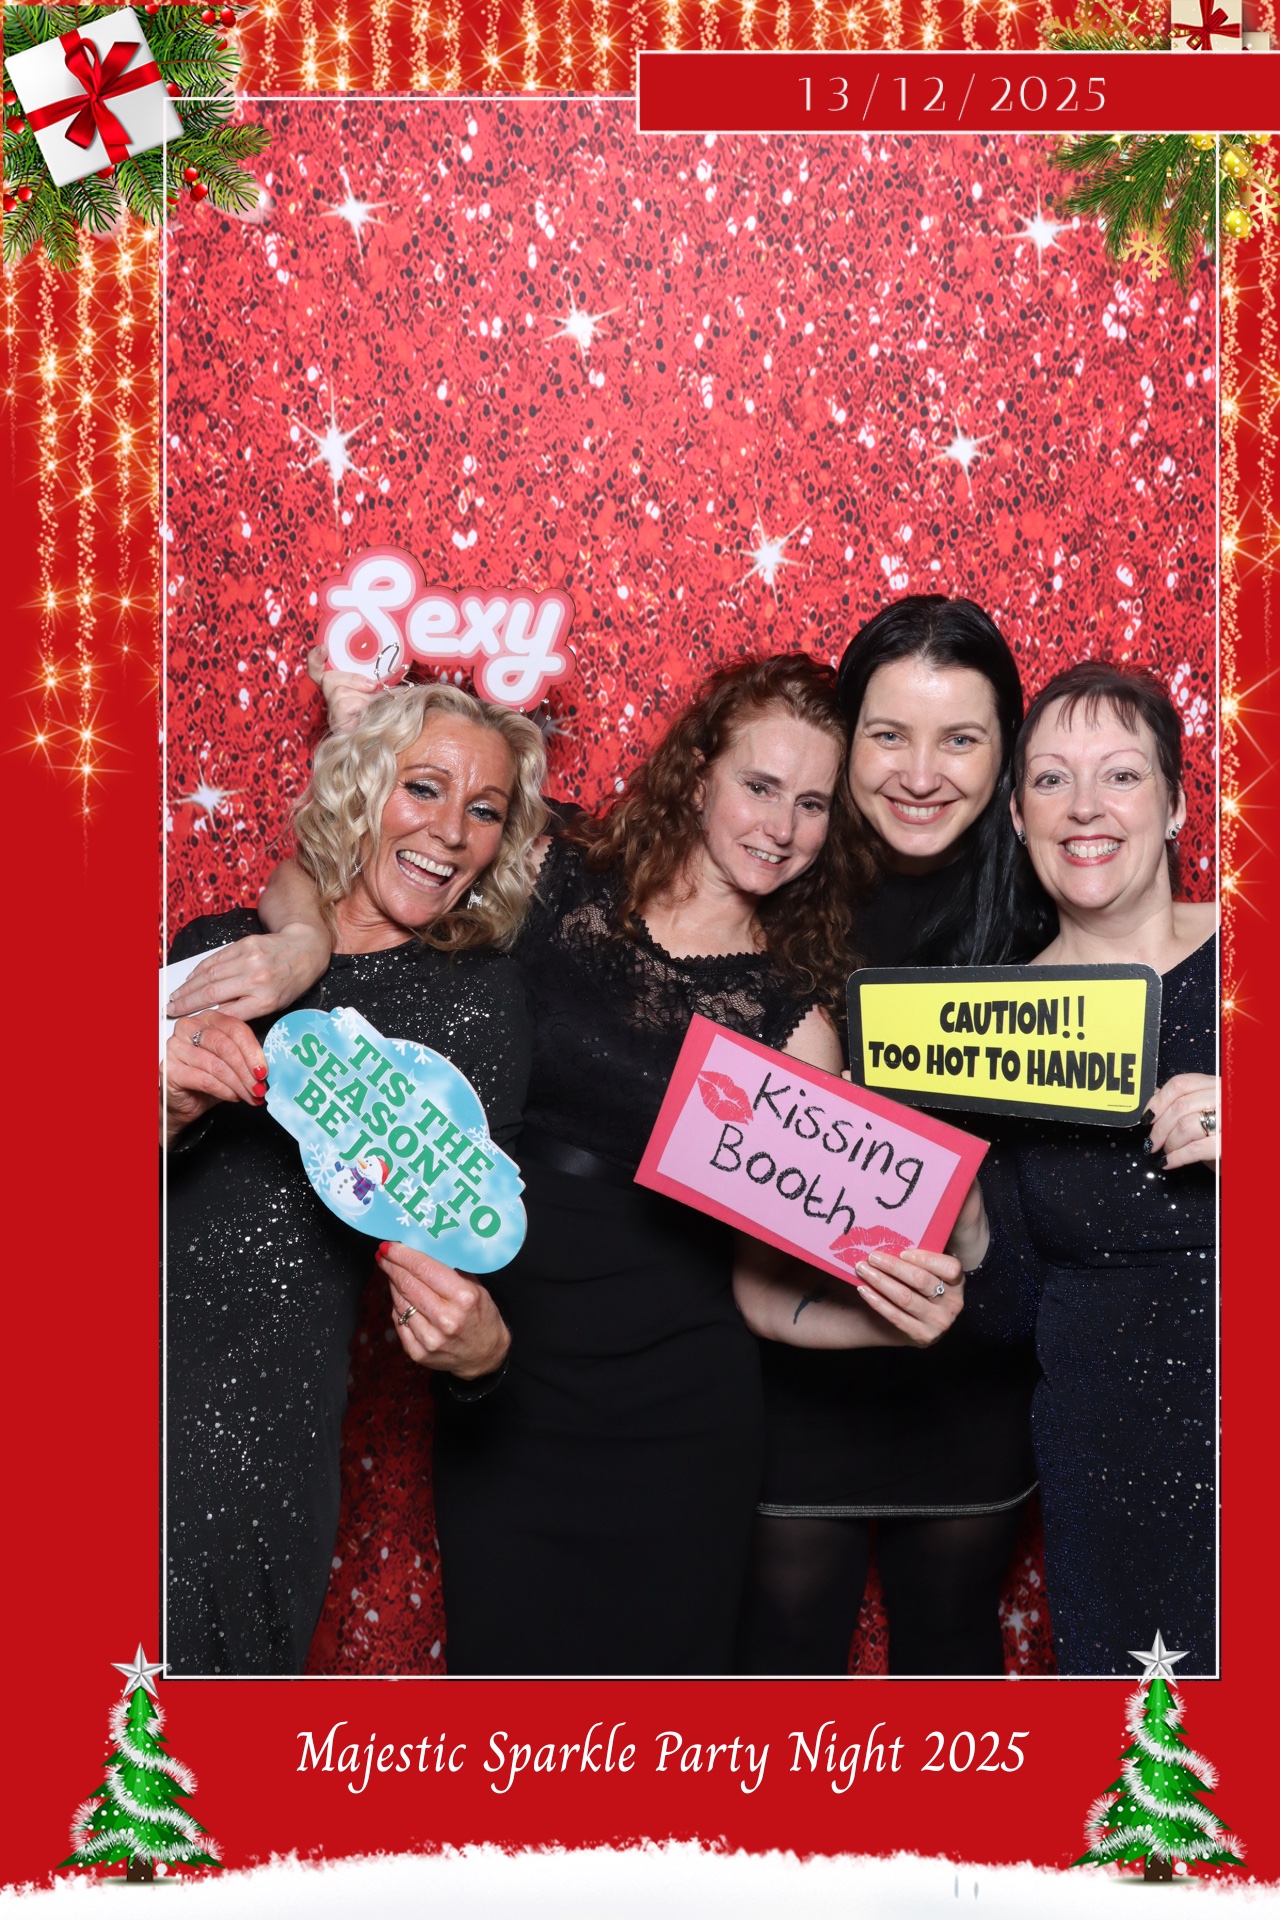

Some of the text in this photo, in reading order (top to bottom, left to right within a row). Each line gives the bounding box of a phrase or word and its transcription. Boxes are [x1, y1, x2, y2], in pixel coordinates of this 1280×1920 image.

[328, 559, 562, 702] Sexy
[868, 1041, 1136, 1095] TOO HOT TO HANDLE
[939, 995, 1085, 1040] CAUTION!!
[290, 1033, 502, 1239] SEASON TO
[295, 1079, 350, 1138] BE
[348, 1034, 495, 1185] TIS THE
[752, 1072, 924, 1210] Kissing
[709, 1123, 856, 1235] Booth
